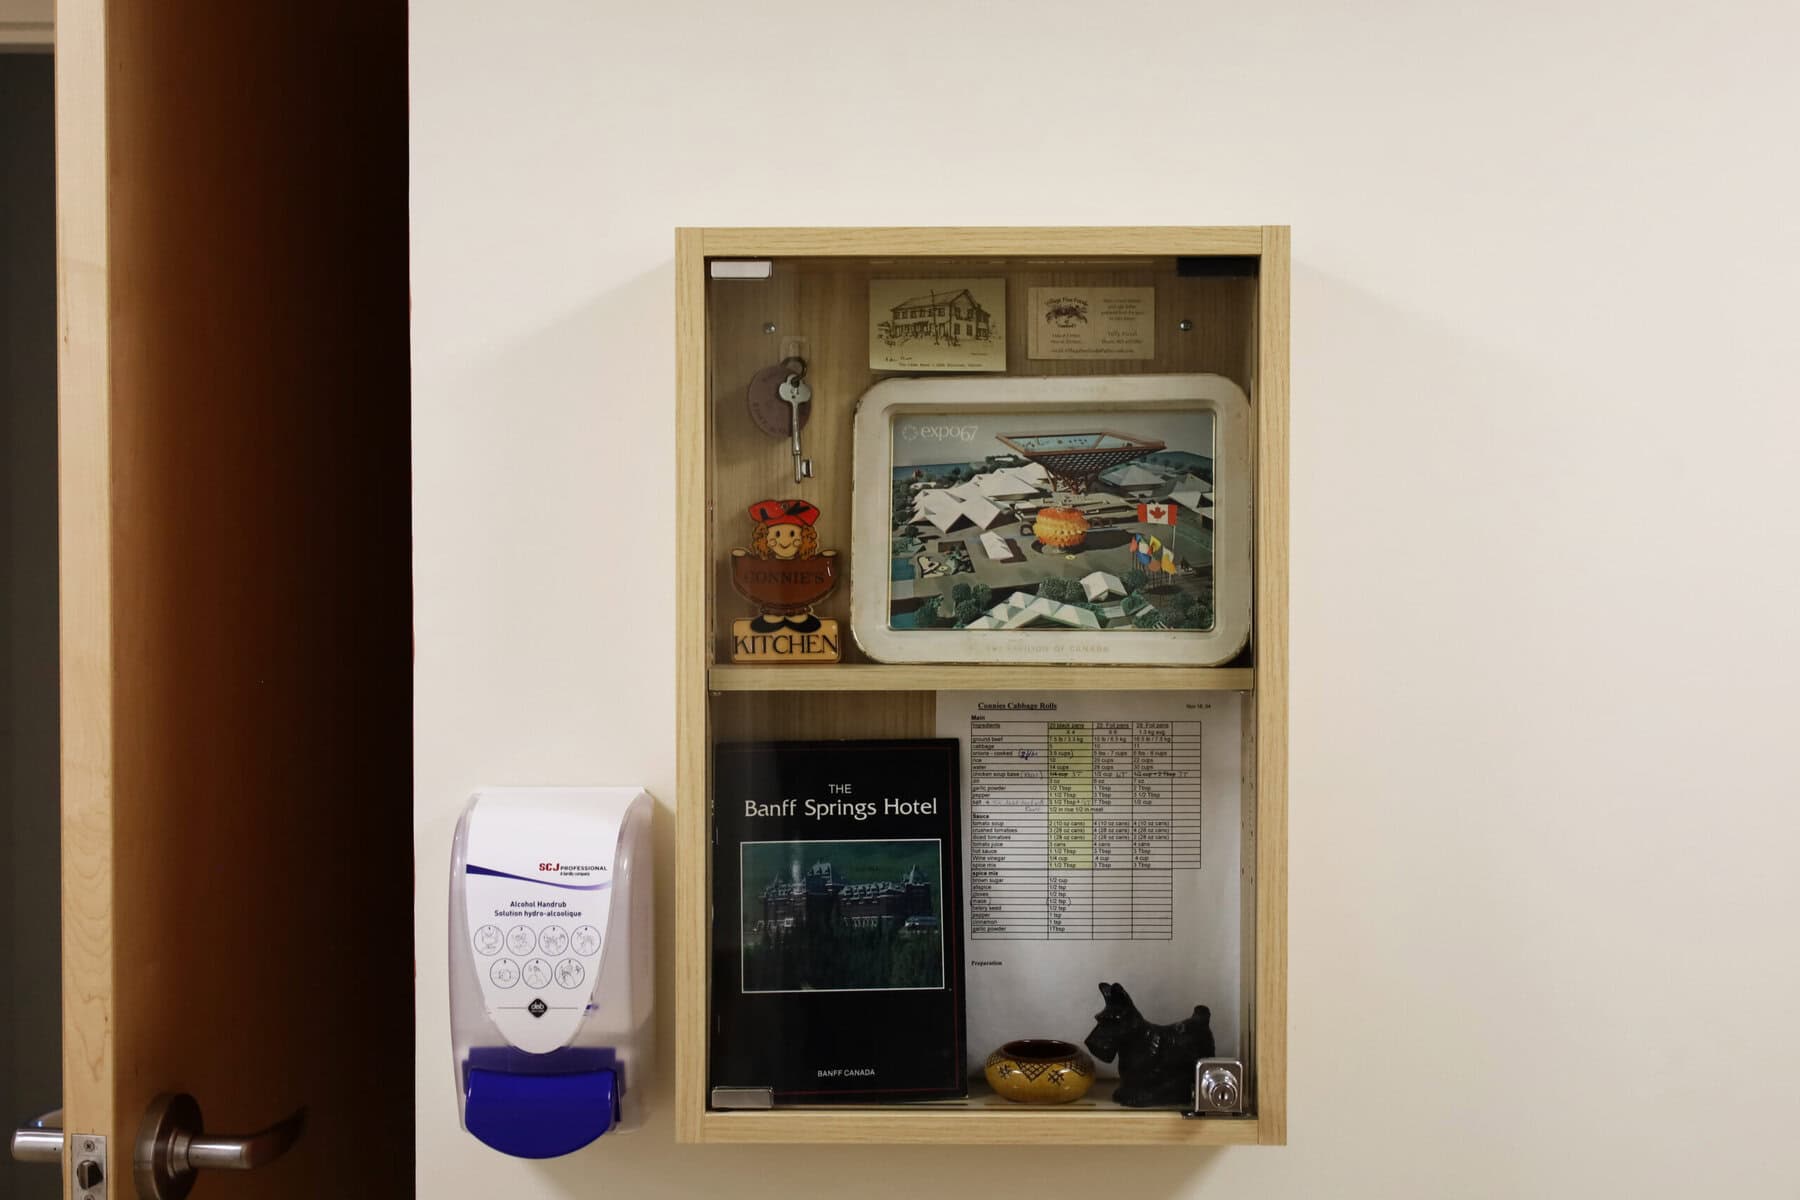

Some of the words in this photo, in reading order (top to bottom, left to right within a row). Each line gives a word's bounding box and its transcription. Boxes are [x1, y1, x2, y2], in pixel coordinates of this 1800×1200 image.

[734, 634, 838, 655] KITCHEN
[1007, 702, 1038, 710] Cabbage
[828, 784, 852, 794] THE
[744, 799, 798, 817] Banff
[804, 798, 877, 820] Springs
[884, 798, 937, 816] Hotel
[539, 863, 560, 871] SCJ
[524, 910, 582, 918] hydro-alcoolique
[530, 1002, 544, 1010] deb
[817, 1070, 843, 1078] BANFF
[844, 1068, 876, 1077] CANADA
